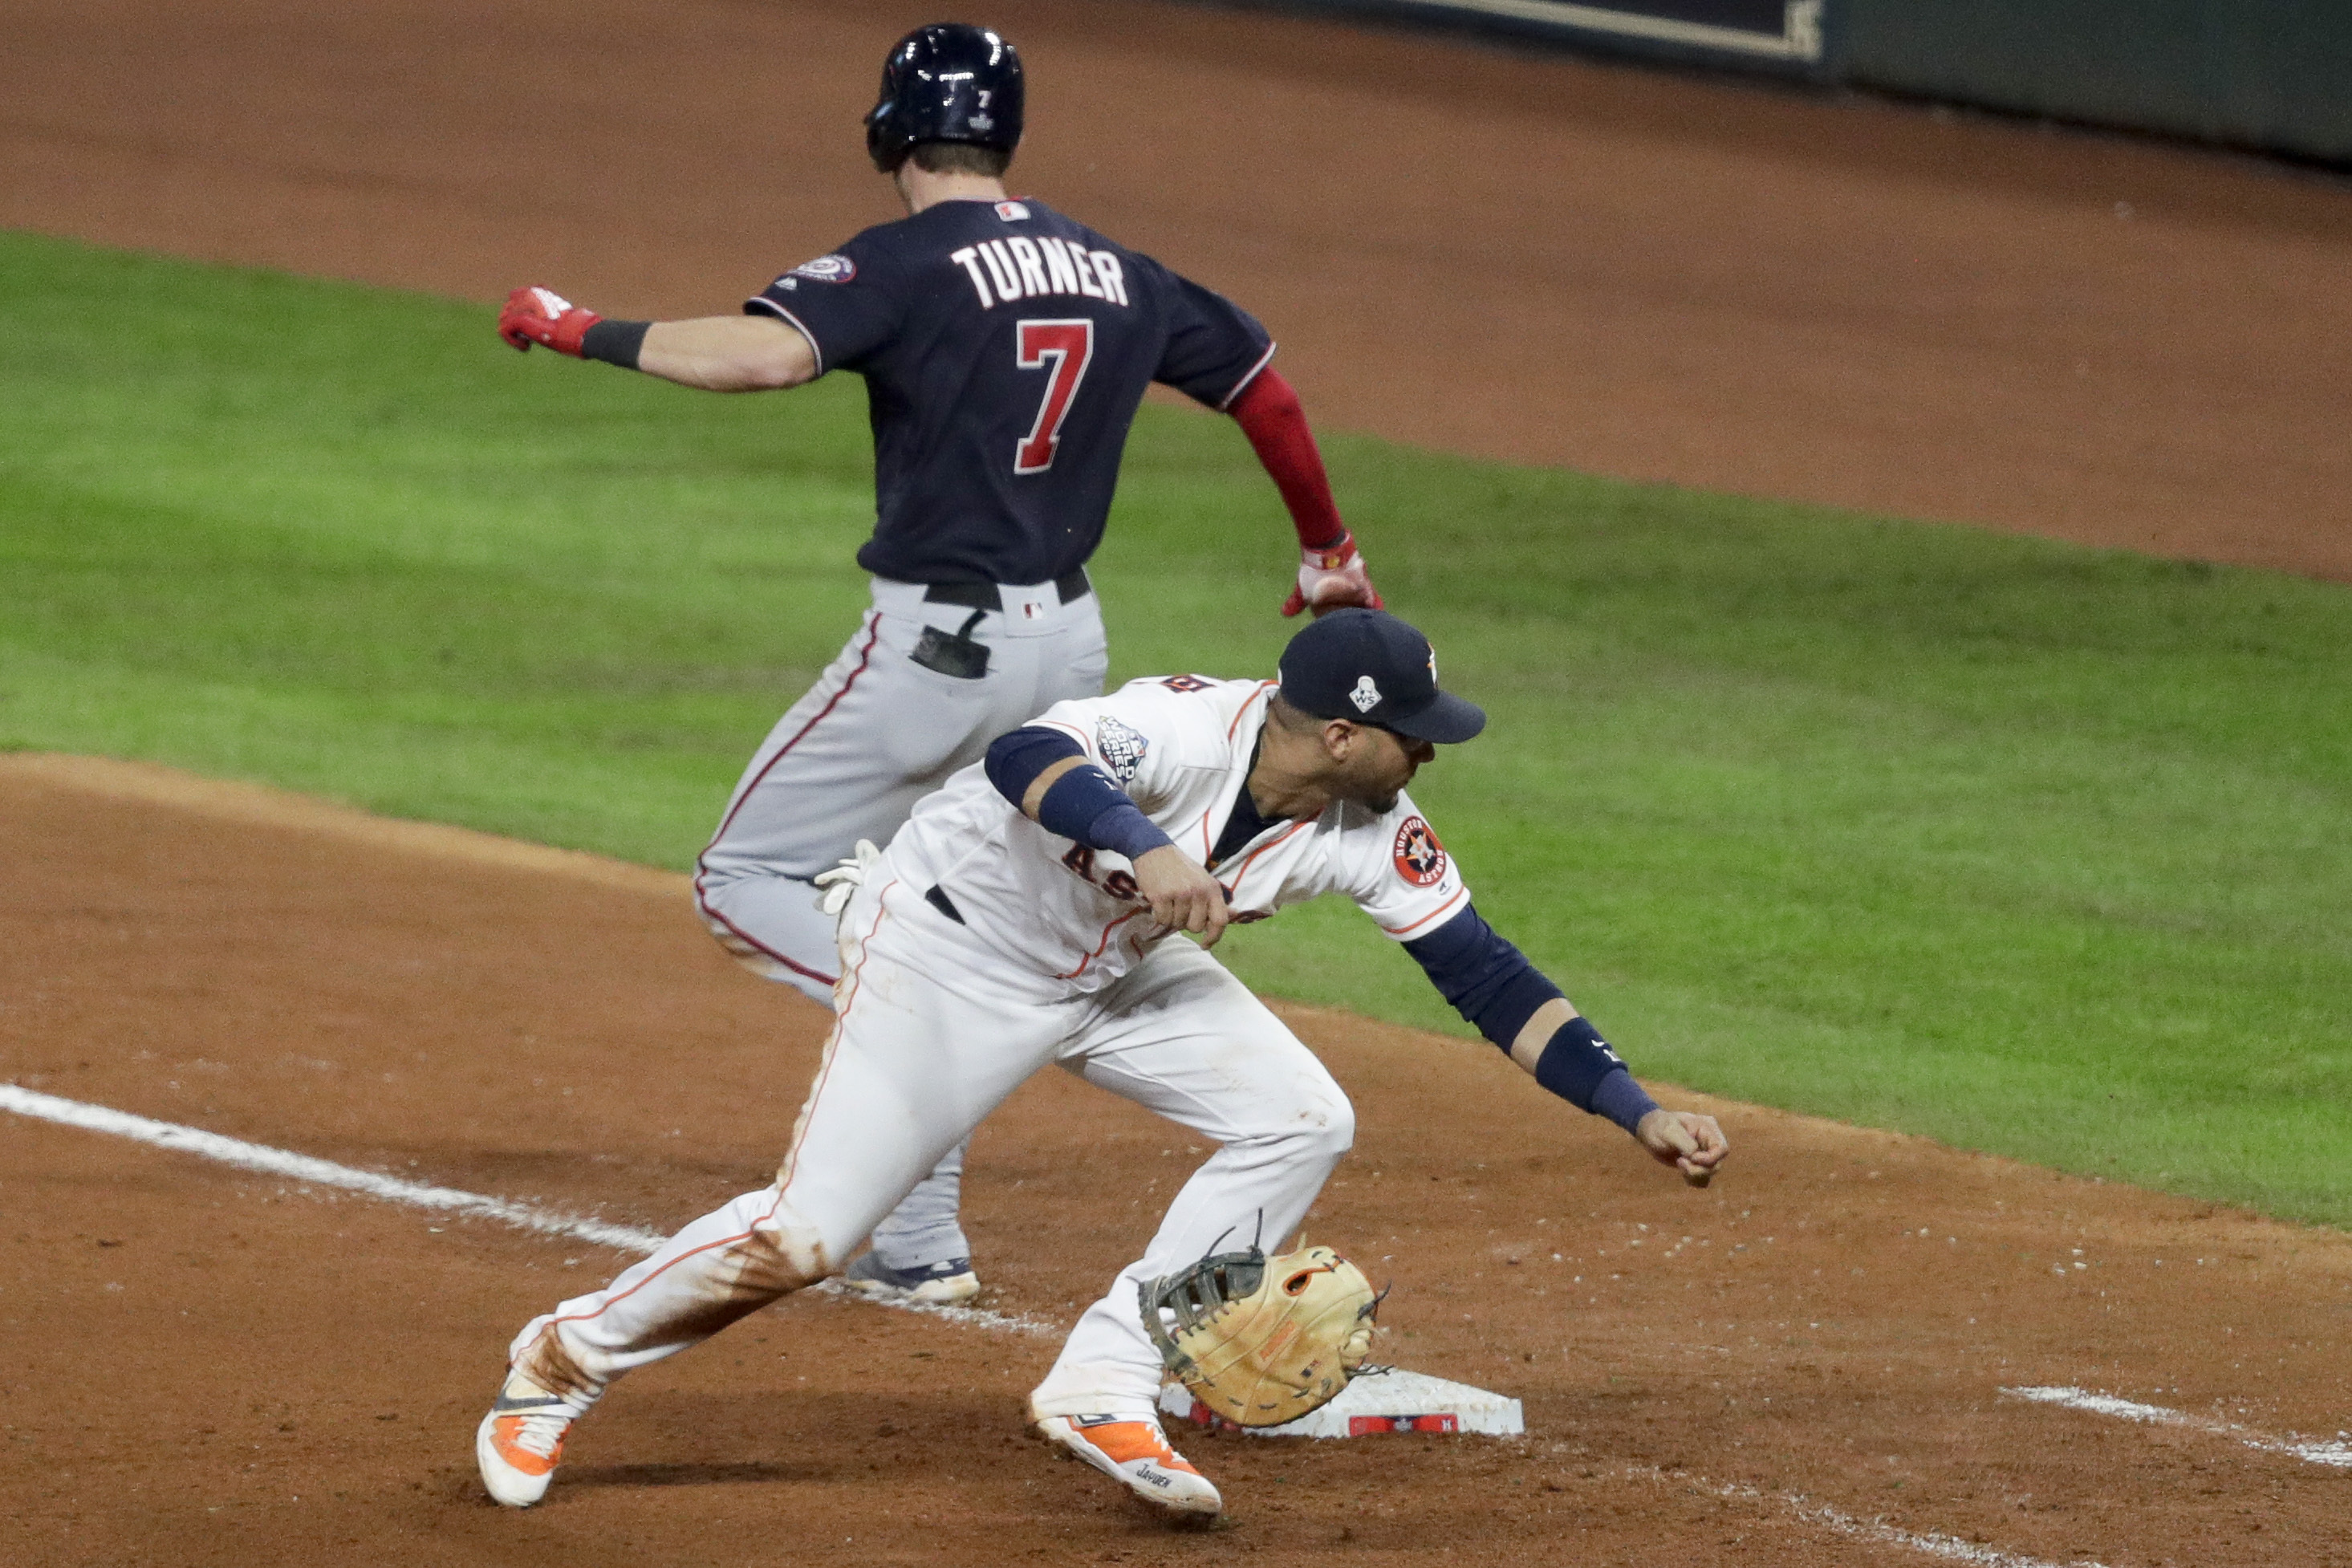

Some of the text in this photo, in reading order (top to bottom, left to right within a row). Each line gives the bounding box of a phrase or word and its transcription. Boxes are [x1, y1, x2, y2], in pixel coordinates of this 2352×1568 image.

[978, 90, 992, 108] 7
[950, 236, 1129, 311] TURNER
[1014, 319, 1094, 474] 7
[1355, 695, 1375, 705] WS
[1100, 721, 1126, 778] SERIES
[1107, 716, 1135, 779] WORLD
[1396, 819, 1423, 857] HOUSTON
[1418, 849, 1444, 884] ASTROS
